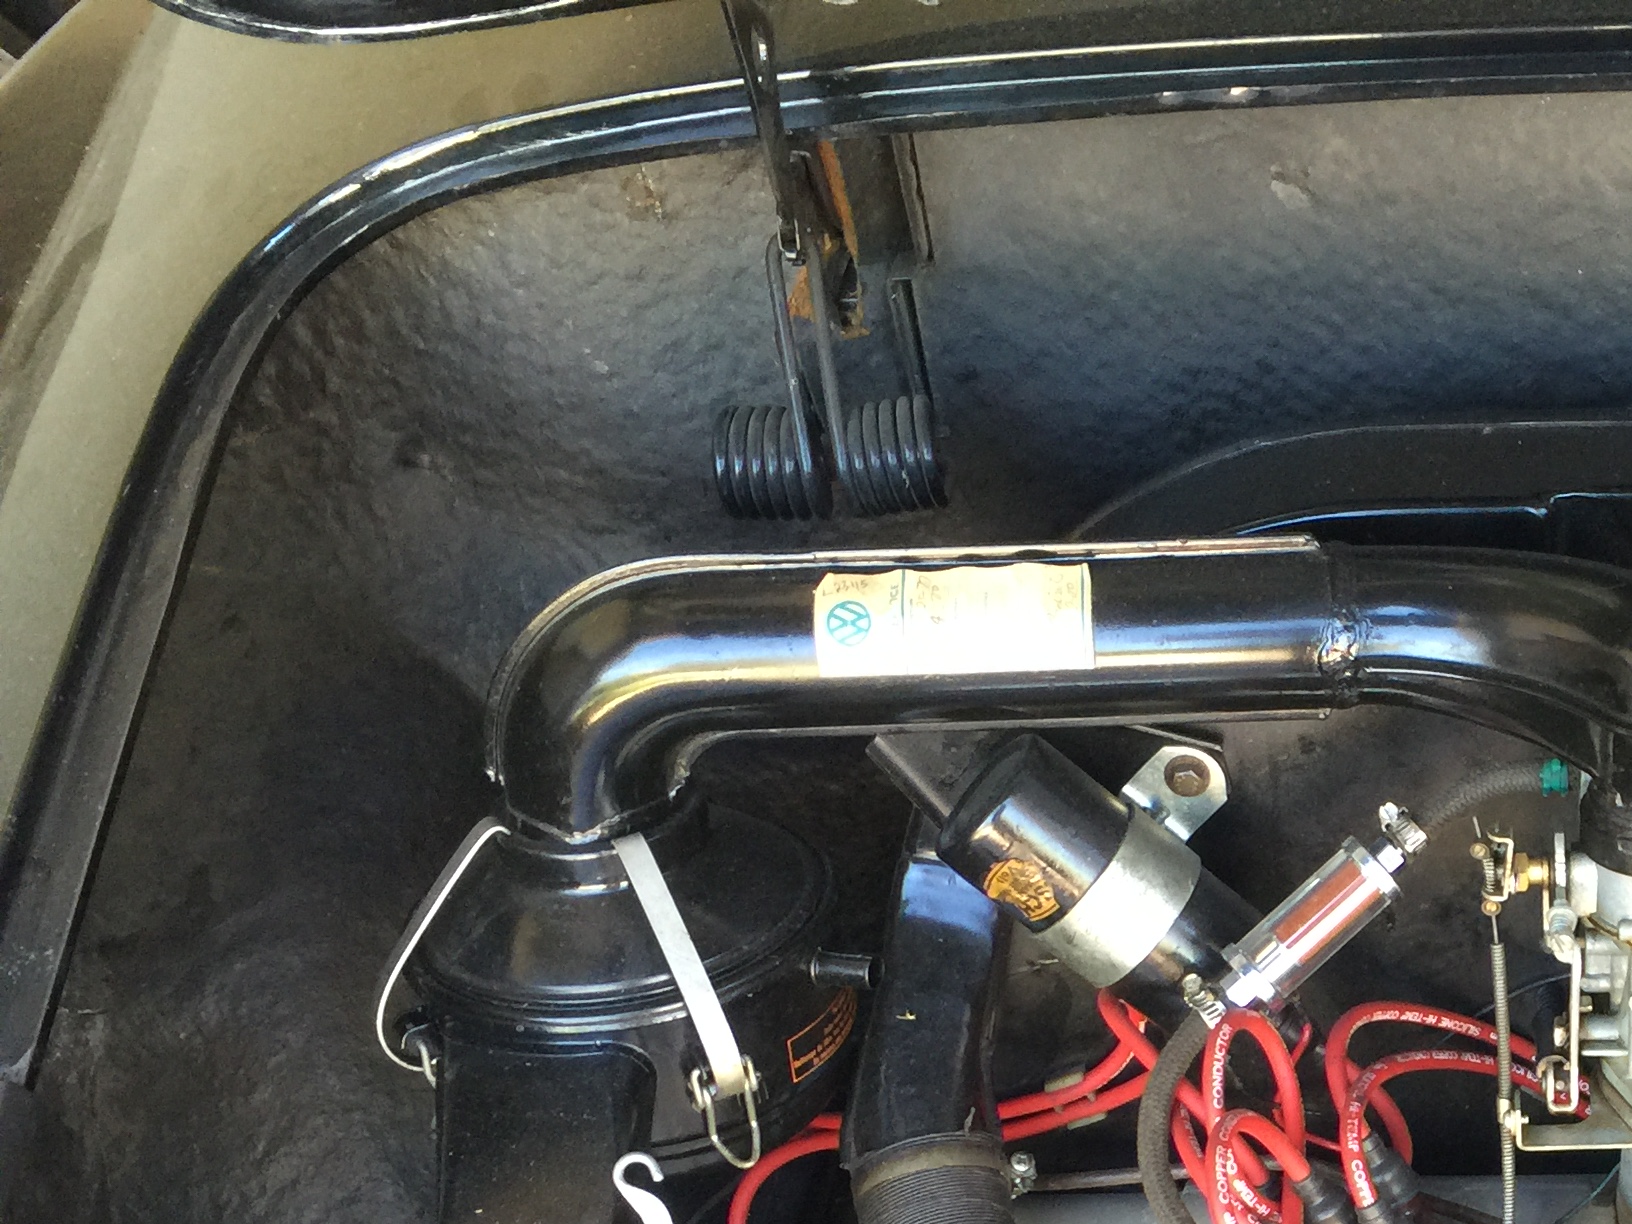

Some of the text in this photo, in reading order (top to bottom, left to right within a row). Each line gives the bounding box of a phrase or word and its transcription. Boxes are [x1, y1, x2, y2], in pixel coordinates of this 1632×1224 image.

[1212, 1023, 1233, 1110] CONDUCTOR
[1215, 1145, 1230, 1205] COPPER
[1232, 1178, 1271, 1217] HI-TEMP
